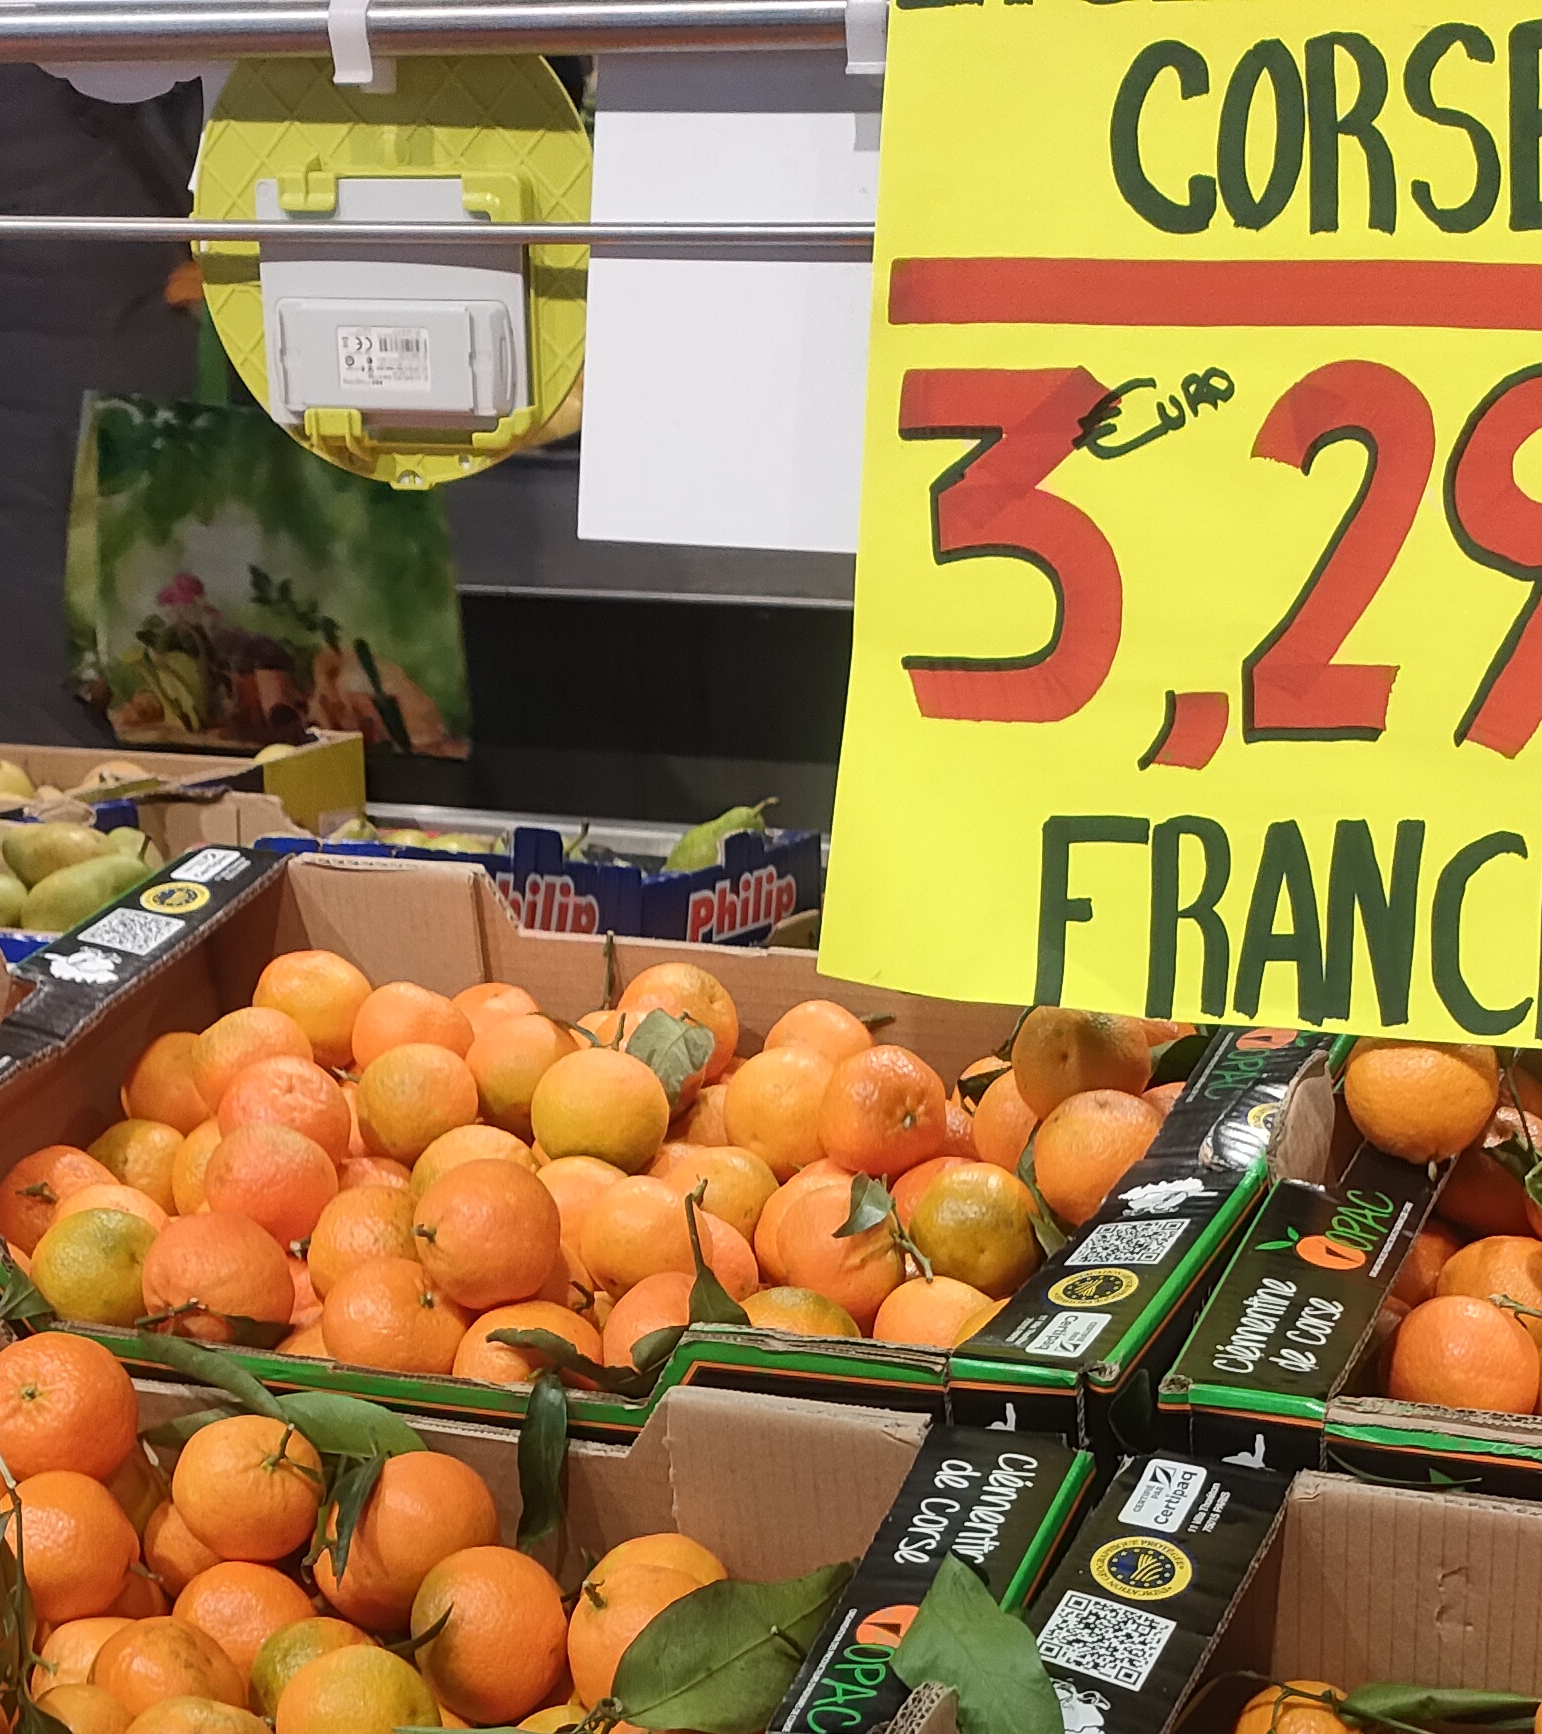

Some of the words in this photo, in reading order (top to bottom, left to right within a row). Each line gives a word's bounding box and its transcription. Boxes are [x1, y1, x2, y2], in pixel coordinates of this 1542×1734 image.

[686, 865, 797, 943] Philip
[1325, 1189, 1394, 1251] OPAC
[1213, 1277, 1298, 1373] Clémentine
[1286, 1297, 1345, 1346] Corse
[1269, 1348, 1317, 1373] de
[934, 1459, 982, 1489] de
[1154, 1470, 1198, 1524] Certipaq
[893, 1497, 961, 1564] Corse
[807, 1644, 895, 1734] OPAC
